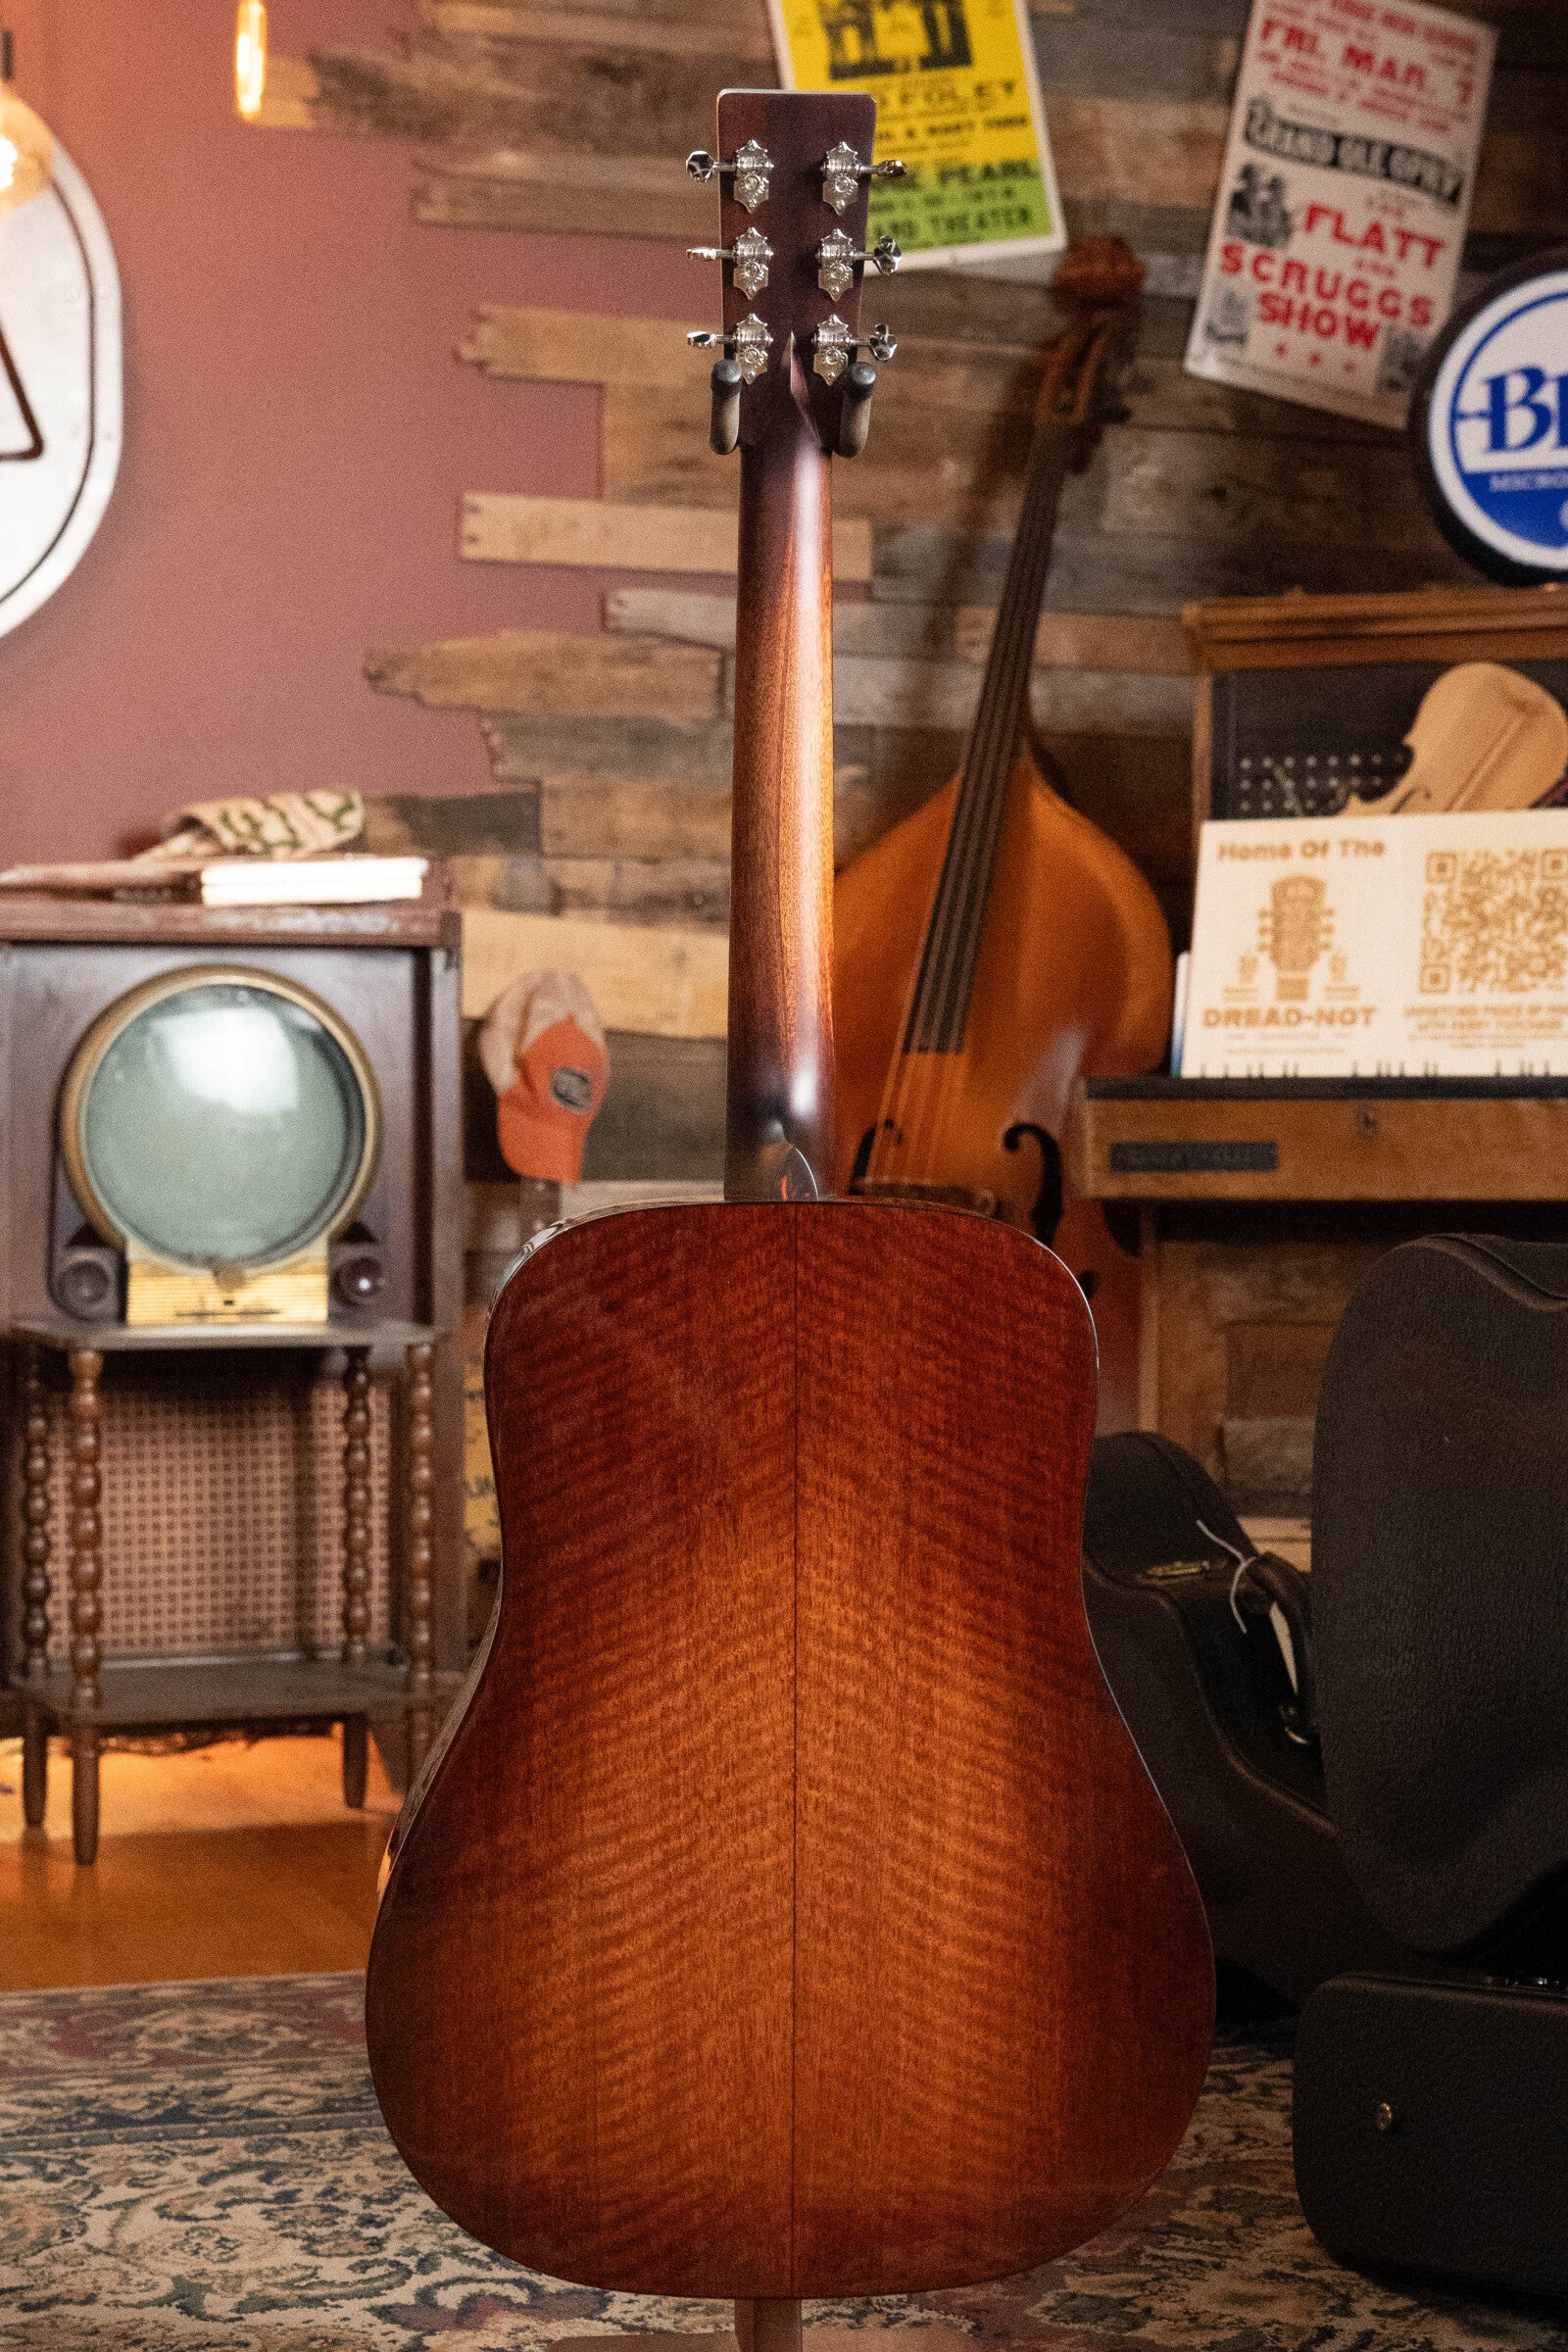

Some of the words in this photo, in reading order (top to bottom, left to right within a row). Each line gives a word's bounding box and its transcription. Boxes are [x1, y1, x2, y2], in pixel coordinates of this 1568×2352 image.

[1305, 202, 1447, 270] FLATT
[1220, 241, 1434, 327] SCRUGGS
[1257, 291, 1381, 350] SHOW
[1217, 841, 1293, 862] Home
[1299, 839, 1330, 860] Of
[1339, 838, 1386, 859] The
[1202, 1005, 1377, 1029] DREAD-NOT
